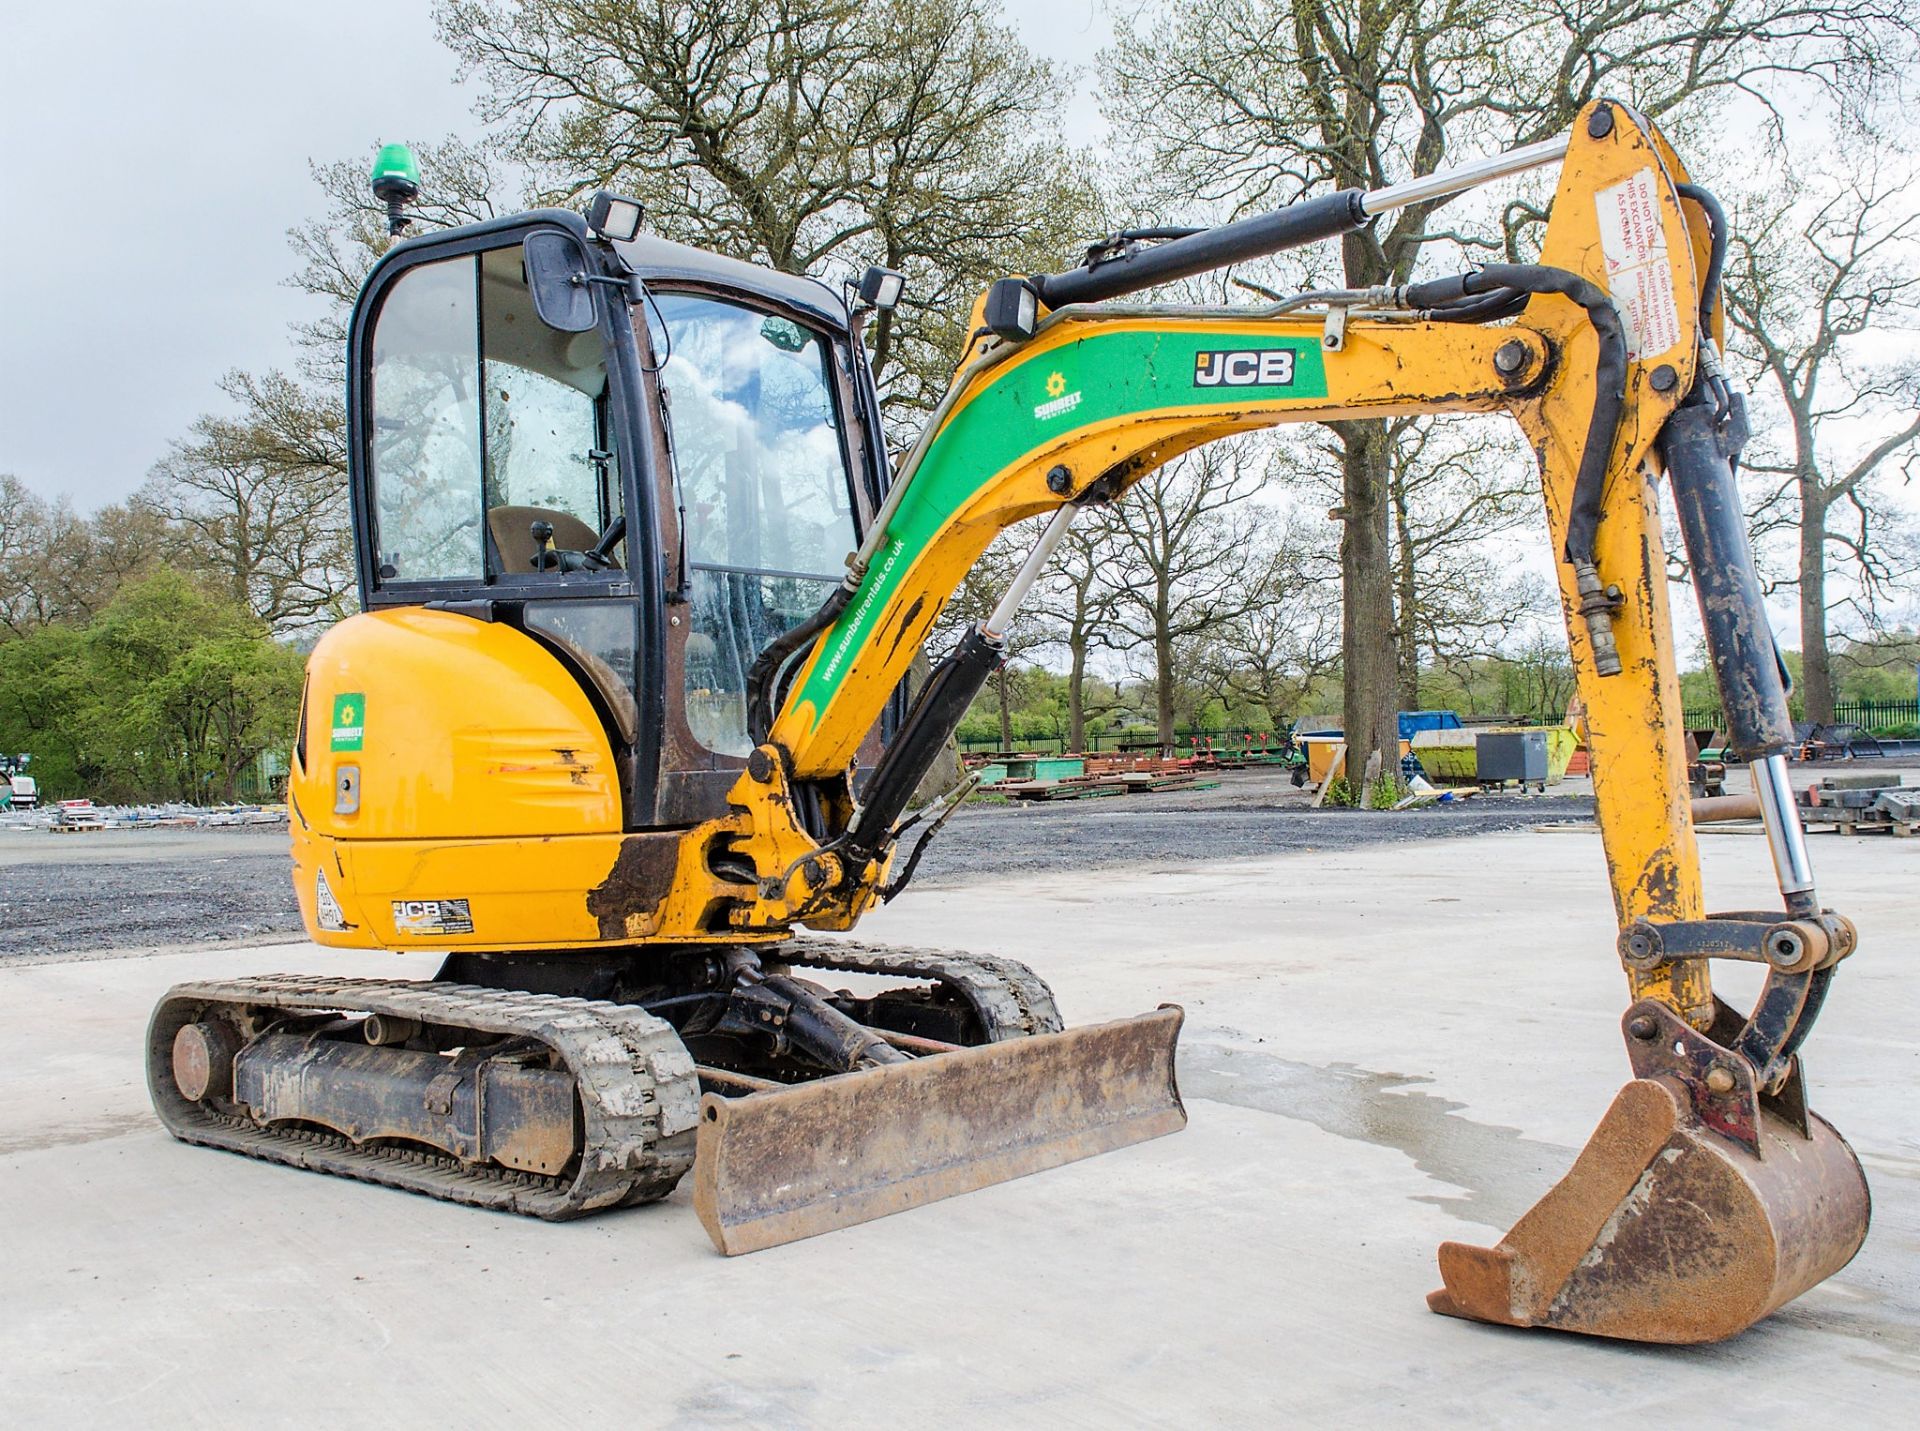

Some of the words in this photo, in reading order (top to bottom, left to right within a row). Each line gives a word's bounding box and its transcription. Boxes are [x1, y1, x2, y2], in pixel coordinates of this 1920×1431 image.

[1627, 177, 1636, 198] THIS
[1640, 184, 1648, 198] DO
[1618, 194, 1626, 206] AS
[1622, 217, 1633, 250] CRANE
[1642, 201, 1652, 222] NOT
[1630, 201, 1646, 260] EXCAVATOR
[1664, 295, 1672, 316] FULLY
[1631, 306, 1640, 333] FITTED
[1196, 352, 1292, 385] JCB
[1034, 390, 1082, 418] SUNBELT
[822, 539, 904, 682] www.sunbeltrentals.co.uk
[395, 902, 440, 917] JCB
